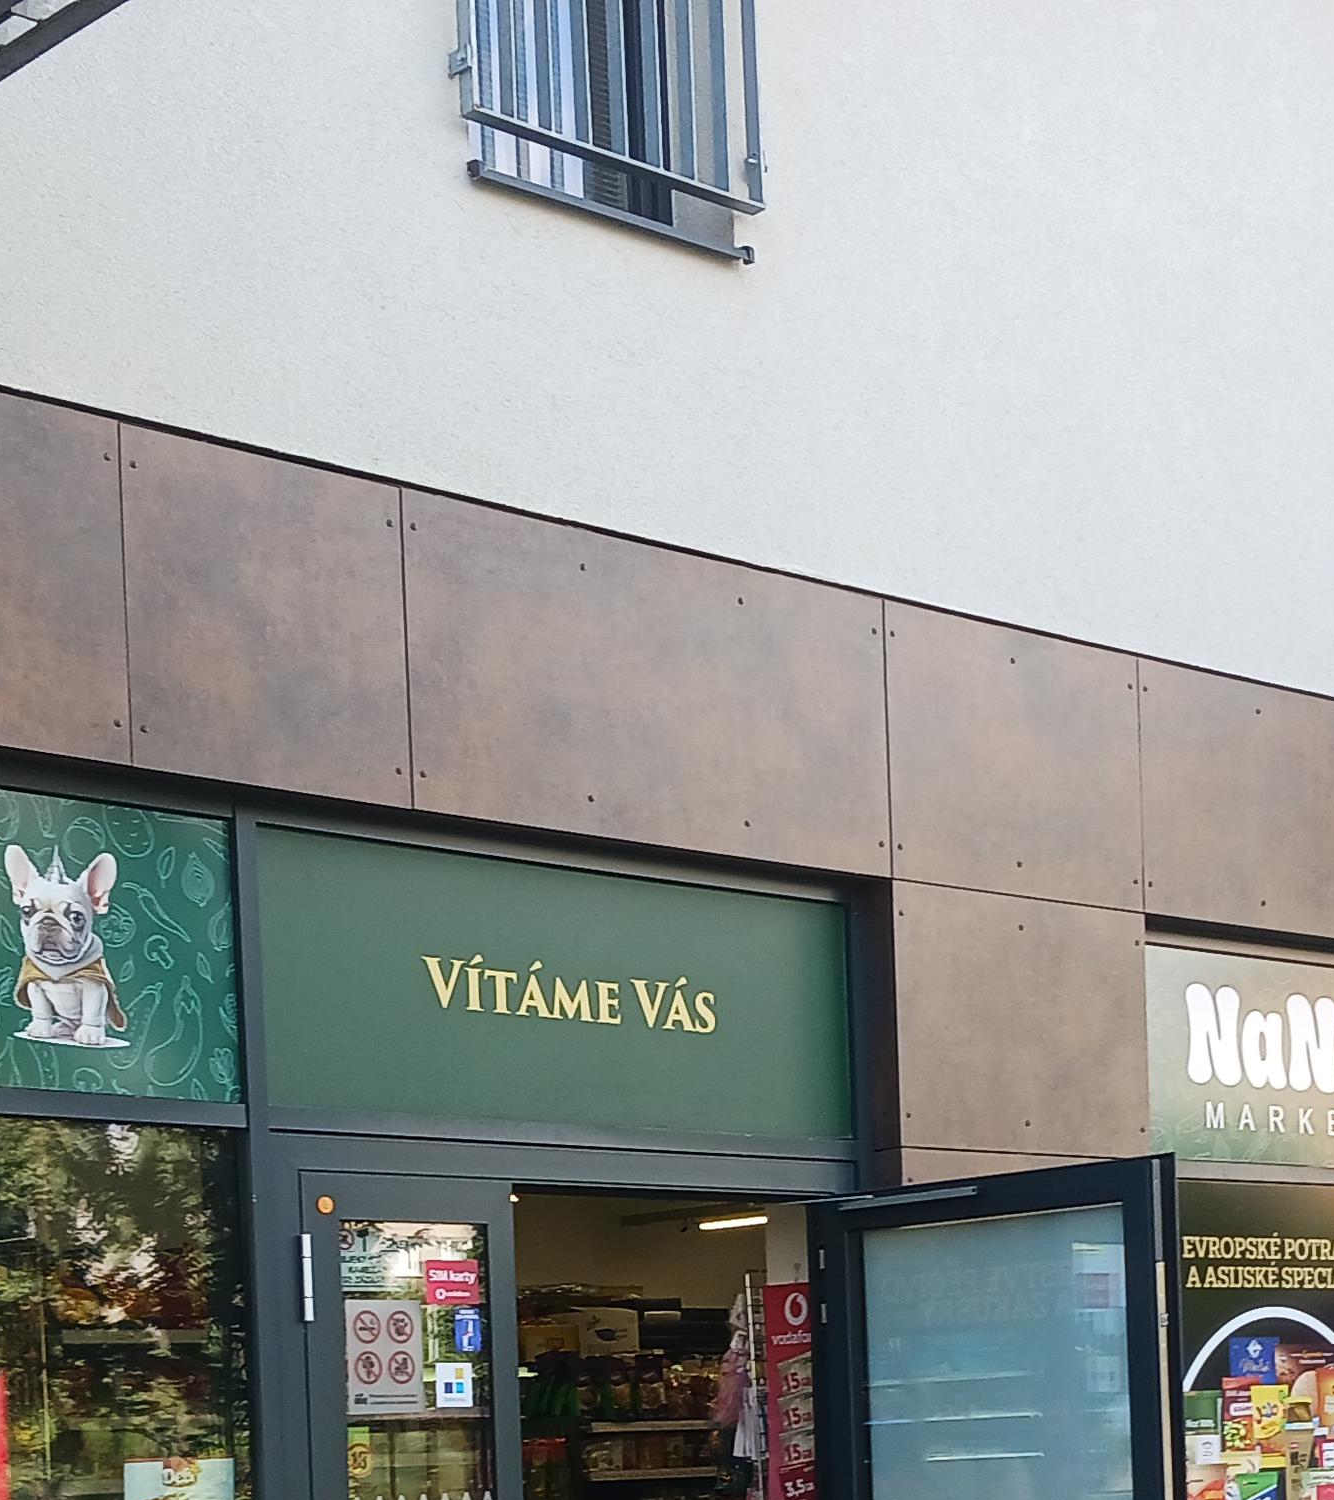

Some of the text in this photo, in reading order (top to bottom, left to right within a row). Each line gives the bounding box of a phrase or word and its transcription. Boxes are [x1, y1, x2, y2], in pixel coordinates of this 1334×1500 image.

[421, 954, 717, 1035] VÍTÁME VÁS
[1181, 1232, 1282, 1260] EVROPSKÉ
[1186, 1265, 1203, 1288] A
